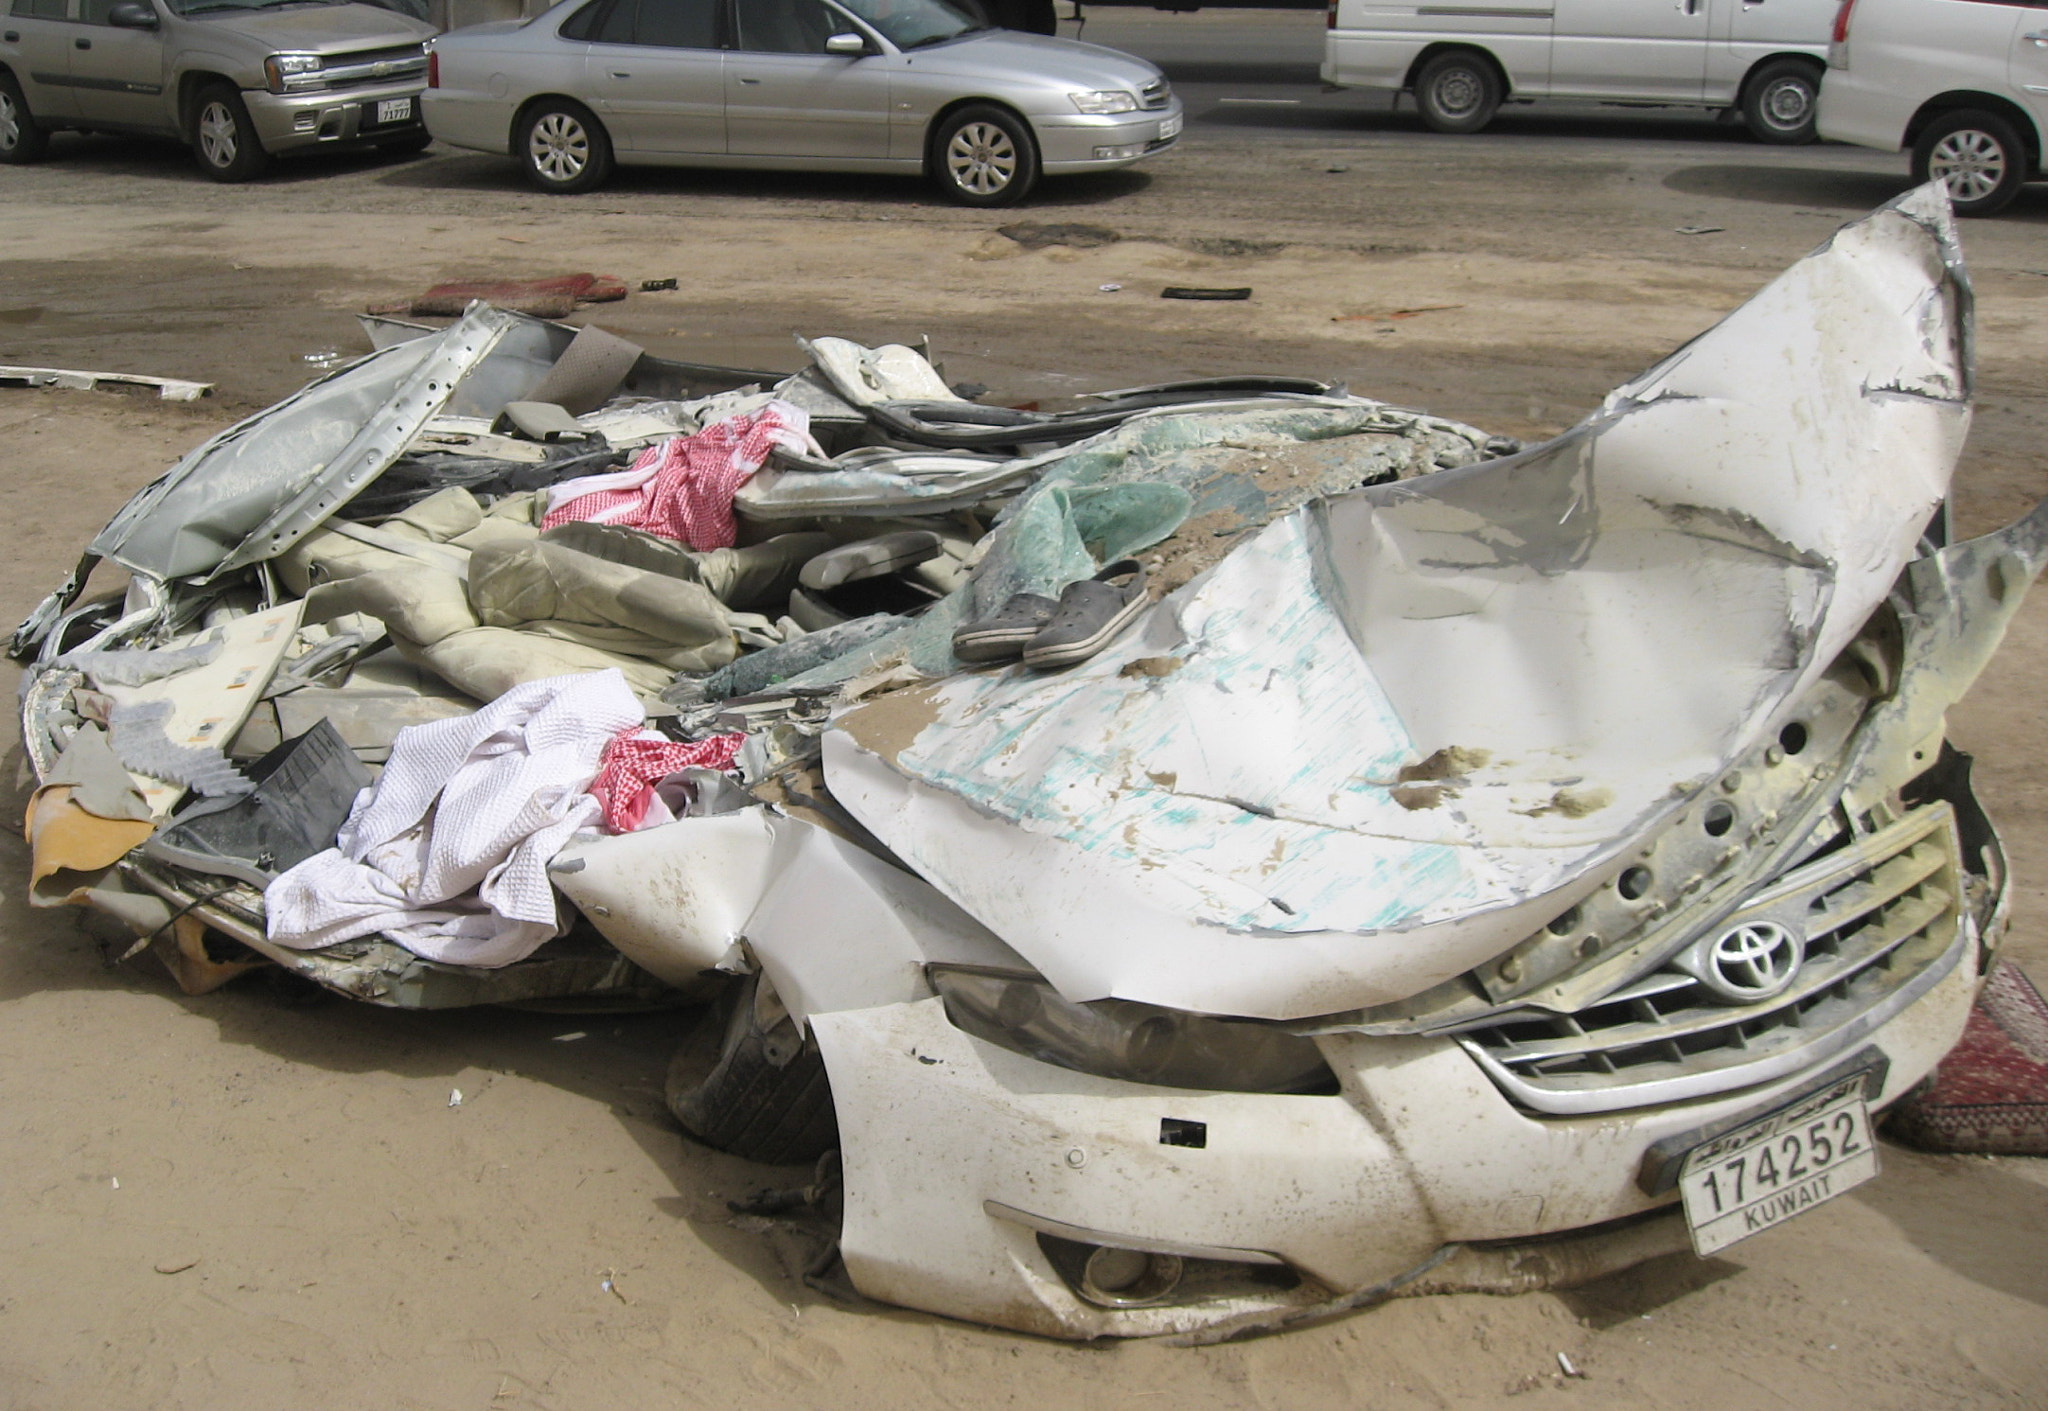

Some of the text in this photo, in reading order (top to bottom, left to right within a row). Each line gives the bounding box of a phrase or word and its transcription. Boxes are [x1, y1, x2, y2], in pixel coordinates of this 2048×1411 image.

[383, 107, 409, 120] 71777
[1702, 1112, 1860, 1213] 174252
[1743, 1174, 1832, 1231] KUWAIT
